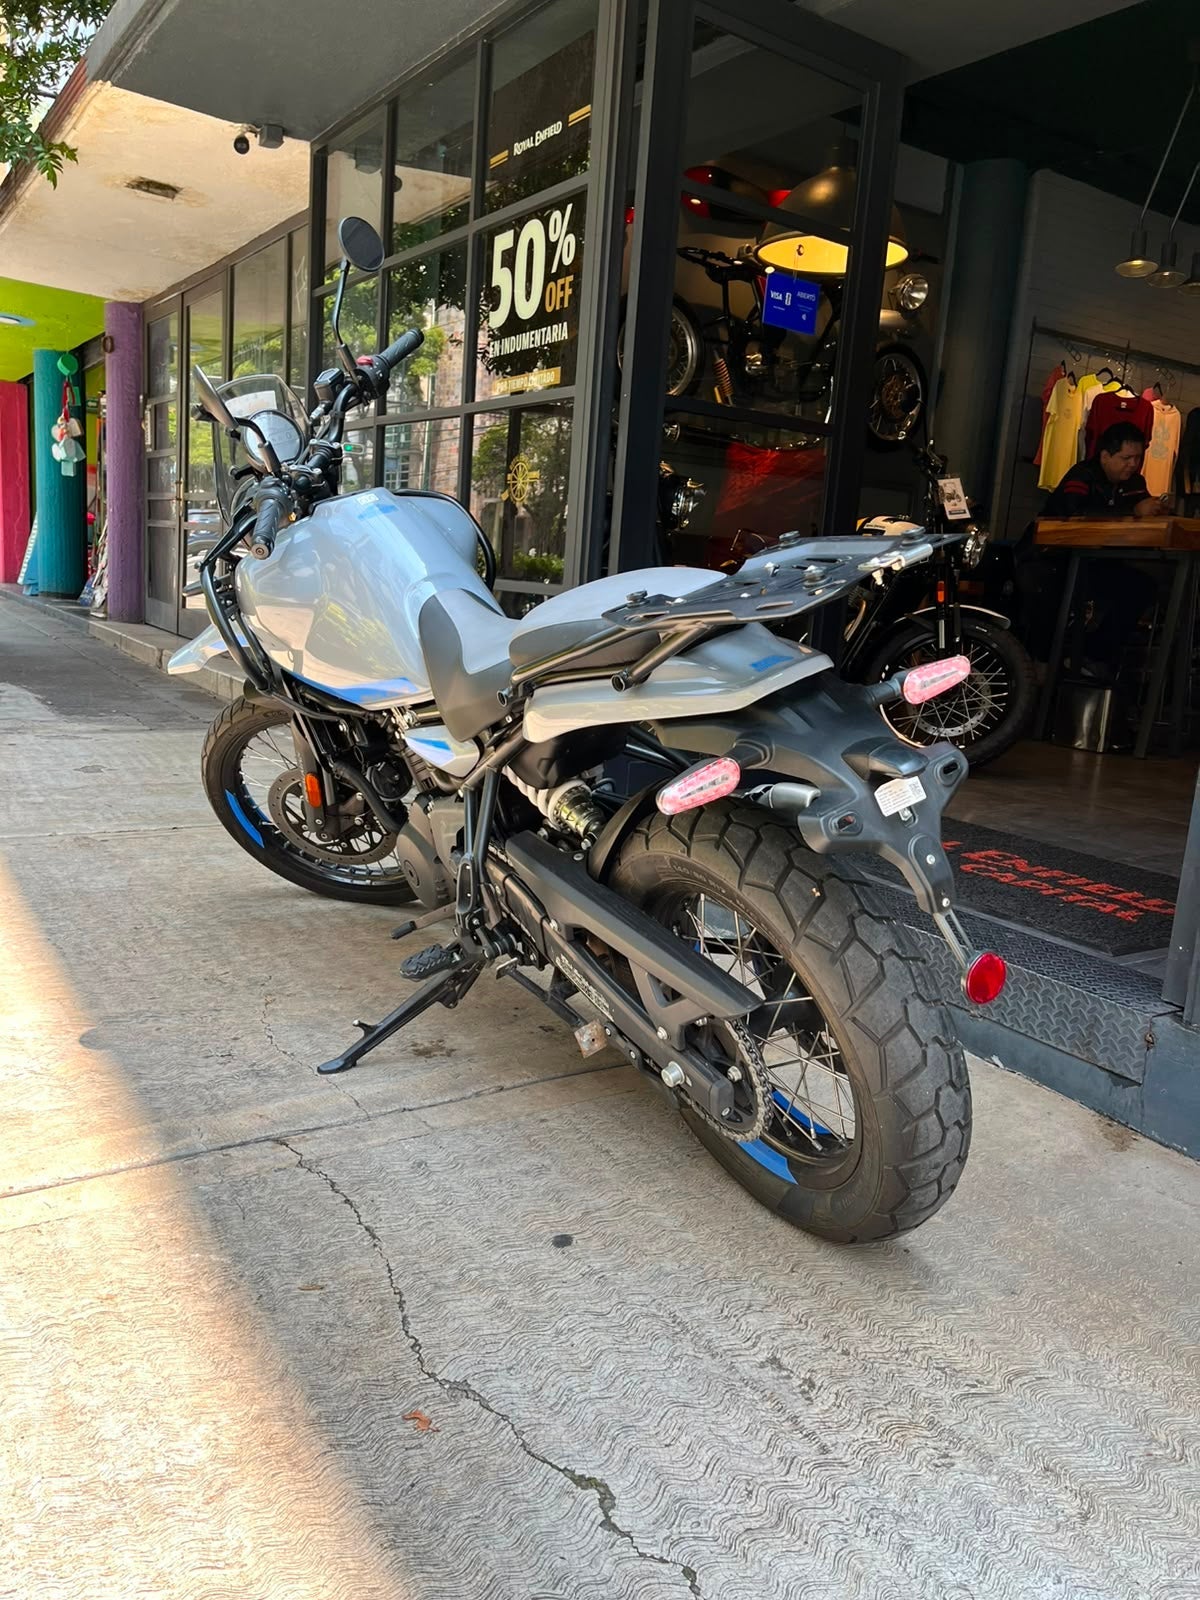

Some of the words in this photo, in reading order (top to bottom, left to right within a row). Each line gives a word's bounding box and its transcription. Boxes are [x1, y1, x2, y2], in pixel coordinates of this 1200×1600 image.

[513, 136, 534, 156] ROYAL
[535, 121, 562, 147] ENFIELD
[489, 203, 576, 330] 50%
[545, 275, 574, 313] OFF
[770, 290, 782, 300] VISA
[489, 340, 500, 358] EN
[501, 321, 568, 355] INDUMENTARIA
